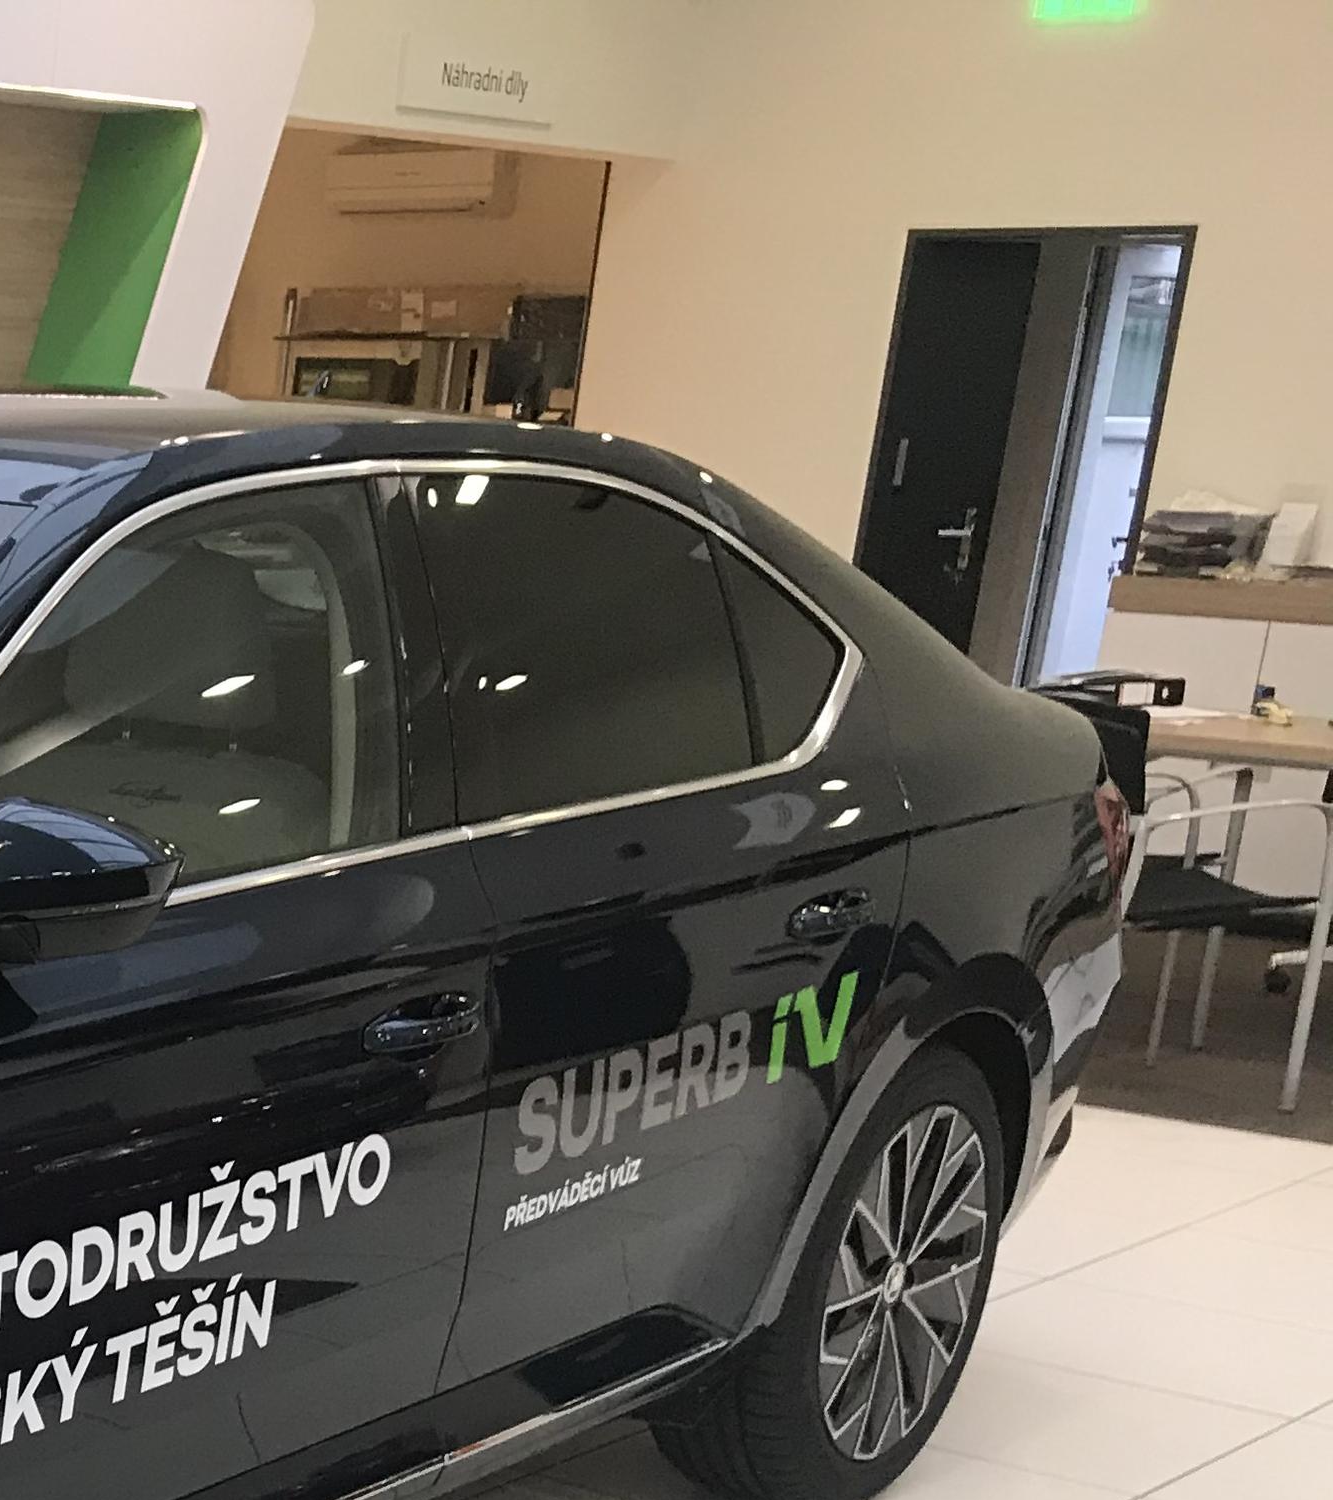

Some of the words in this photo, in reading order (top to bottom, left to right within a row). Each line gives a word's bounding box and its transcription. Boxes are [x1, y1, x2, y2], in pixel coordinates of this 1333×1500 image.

[441, 61, 502, 93] Náhradní
[504, 69, 528, 103] díly
[513, 1009, 752, 1175] SUPERB
[765, 970, 860, 1085] iV
[503, 1163, 611, 1232] PŘEDVÁDĚCÍ
[106, 1273, 277, 1405] TĚŠÍN
